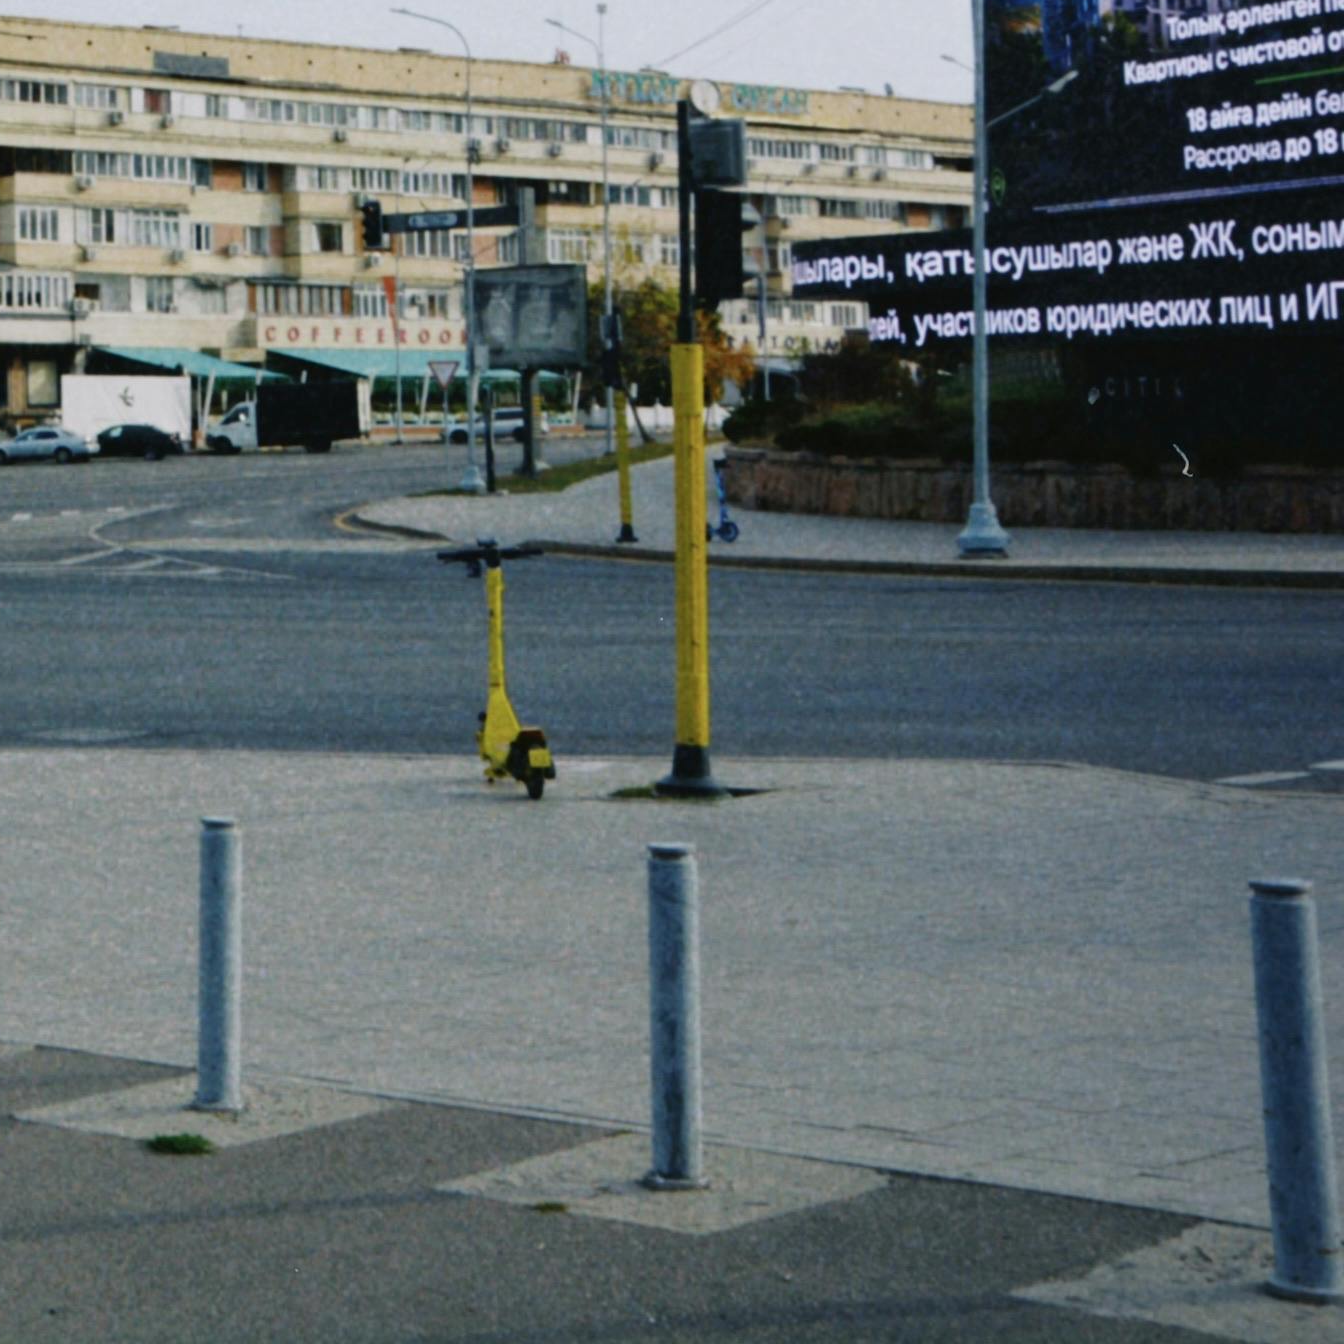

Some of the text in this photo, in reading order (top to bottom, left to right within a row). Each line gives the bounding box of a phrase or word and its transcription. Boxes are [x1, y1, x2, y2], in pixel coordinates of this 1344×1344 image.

[1166, 11, 1226, 41] Толық
[1123, 52, 1214, 86] Квартиры
[1216, 54, 1229, 70] с
[1230, 27, 1325, 67] чистовой
[1185, 106, 1208, 133] 18
[1209, 100, 1254, 131] айға
[1255, 92, 1312, 127] дейін
[1183, 127, 1339, 172] Рассрочка до 18
[1117, 232, 1185, 265] және
[1188, 219, 1245, 262] ЖК,
[1046, 297, 1213, 340] юридических
[1218, 293, 1274, 330] лиц
[1279, 292, 1299, 322] и
